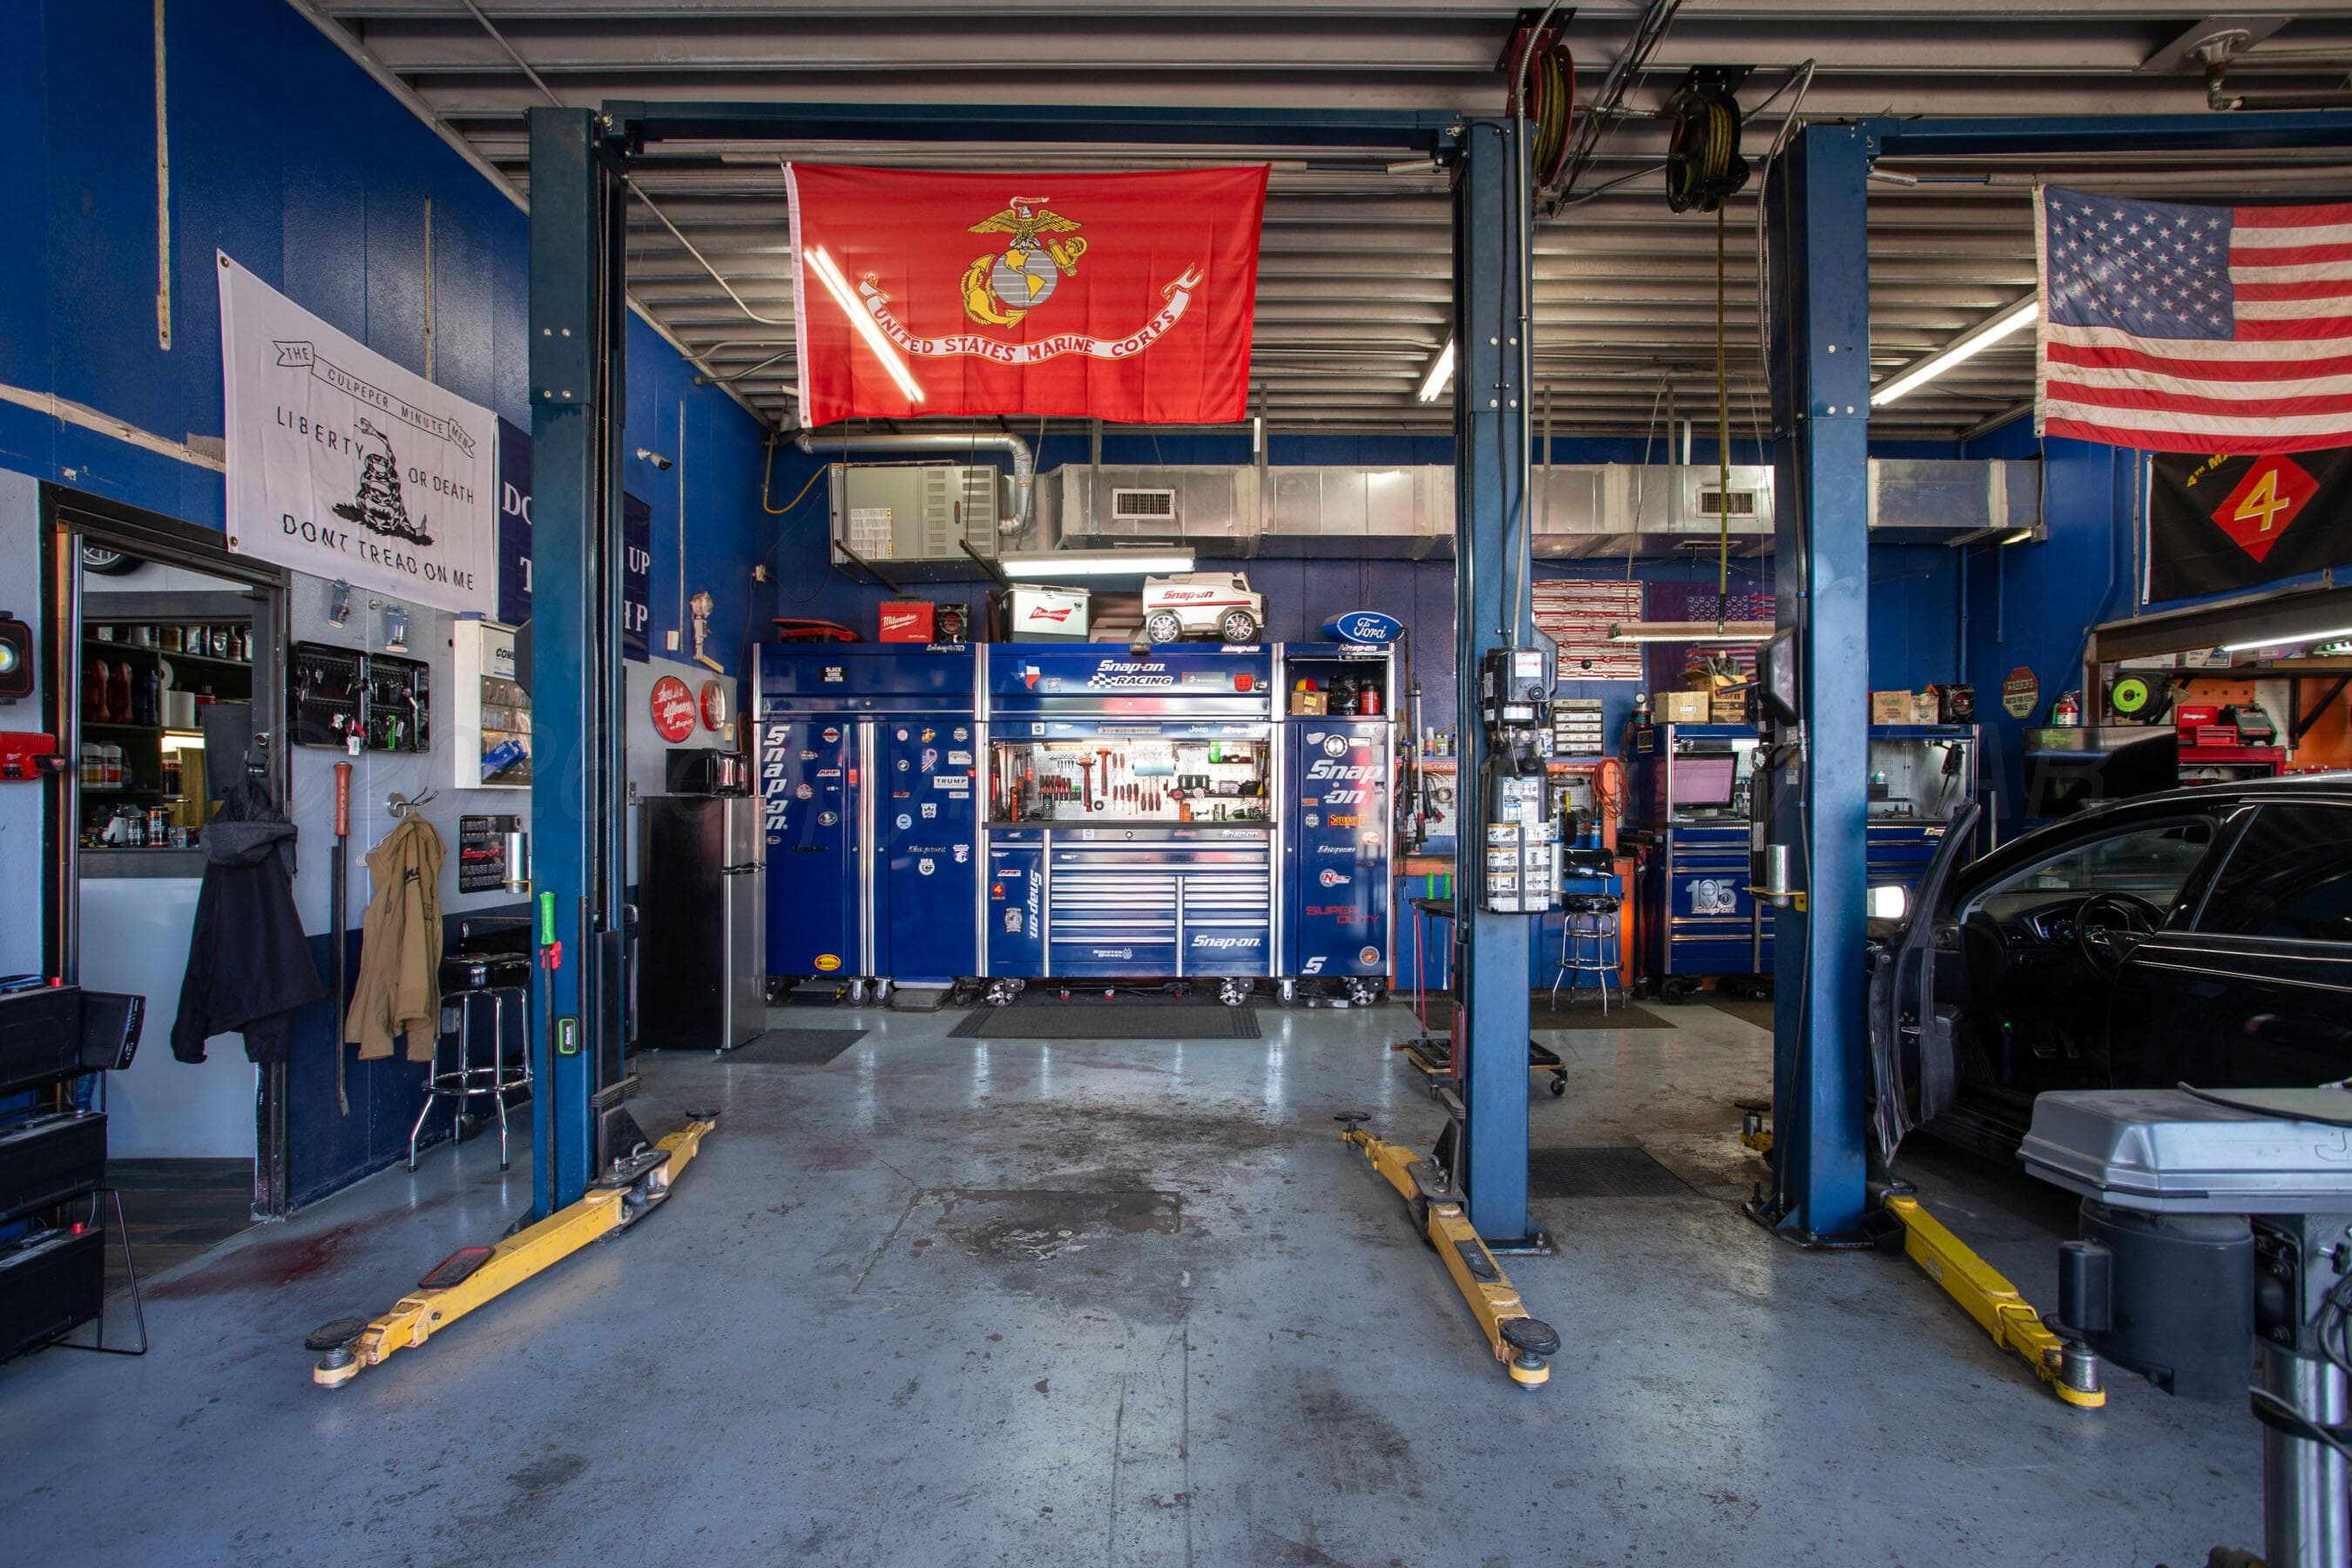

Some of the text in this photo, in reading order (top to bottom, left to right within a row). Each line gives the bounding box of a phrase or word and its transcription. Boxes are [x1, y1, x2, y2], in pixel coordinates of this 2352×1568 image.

[875, 306, 1175, 362] UNITED STATES MARINE CORPS
[285, 347, 310, 362] THE
[328, 368, 444, 433] CULPEPER MINUTE
[451, 425, 470, 449] MEN
[276, 405, 475, 504] LIBERTY OR DEATH
[2234, 470, 2290, 531] 4
[282, 513, 474, 591] DONT TREAD ON ME
[629, 546, 650, 575] UP
[1163, 591, 1214, 601] Snap-on
[883, 613, 917, 629] Milwaukee
[1353, 618, 1387, 639] Ford
[1098, 659, 1166, 674] Snap-on
[1115, 676, 1173, 686] RACING
[1188, 725, 1208, 734] Jeep
[1306, 760, 1384, 784] Snap
[1329, 814, 1357, 826] Semper
[1221, 829, 1259, 839] Snap-on
[462, 846, 499, 860] Snap-on
[1027, 869, 1043, 939] Snap-on
[1306, 905, 1359, 916] SUPER
[1692, 906, 1735, 915] Snap-on
[1337, 915, 1380, 925] DUTY
[1193, 935, 1261, 950] Snap-on
